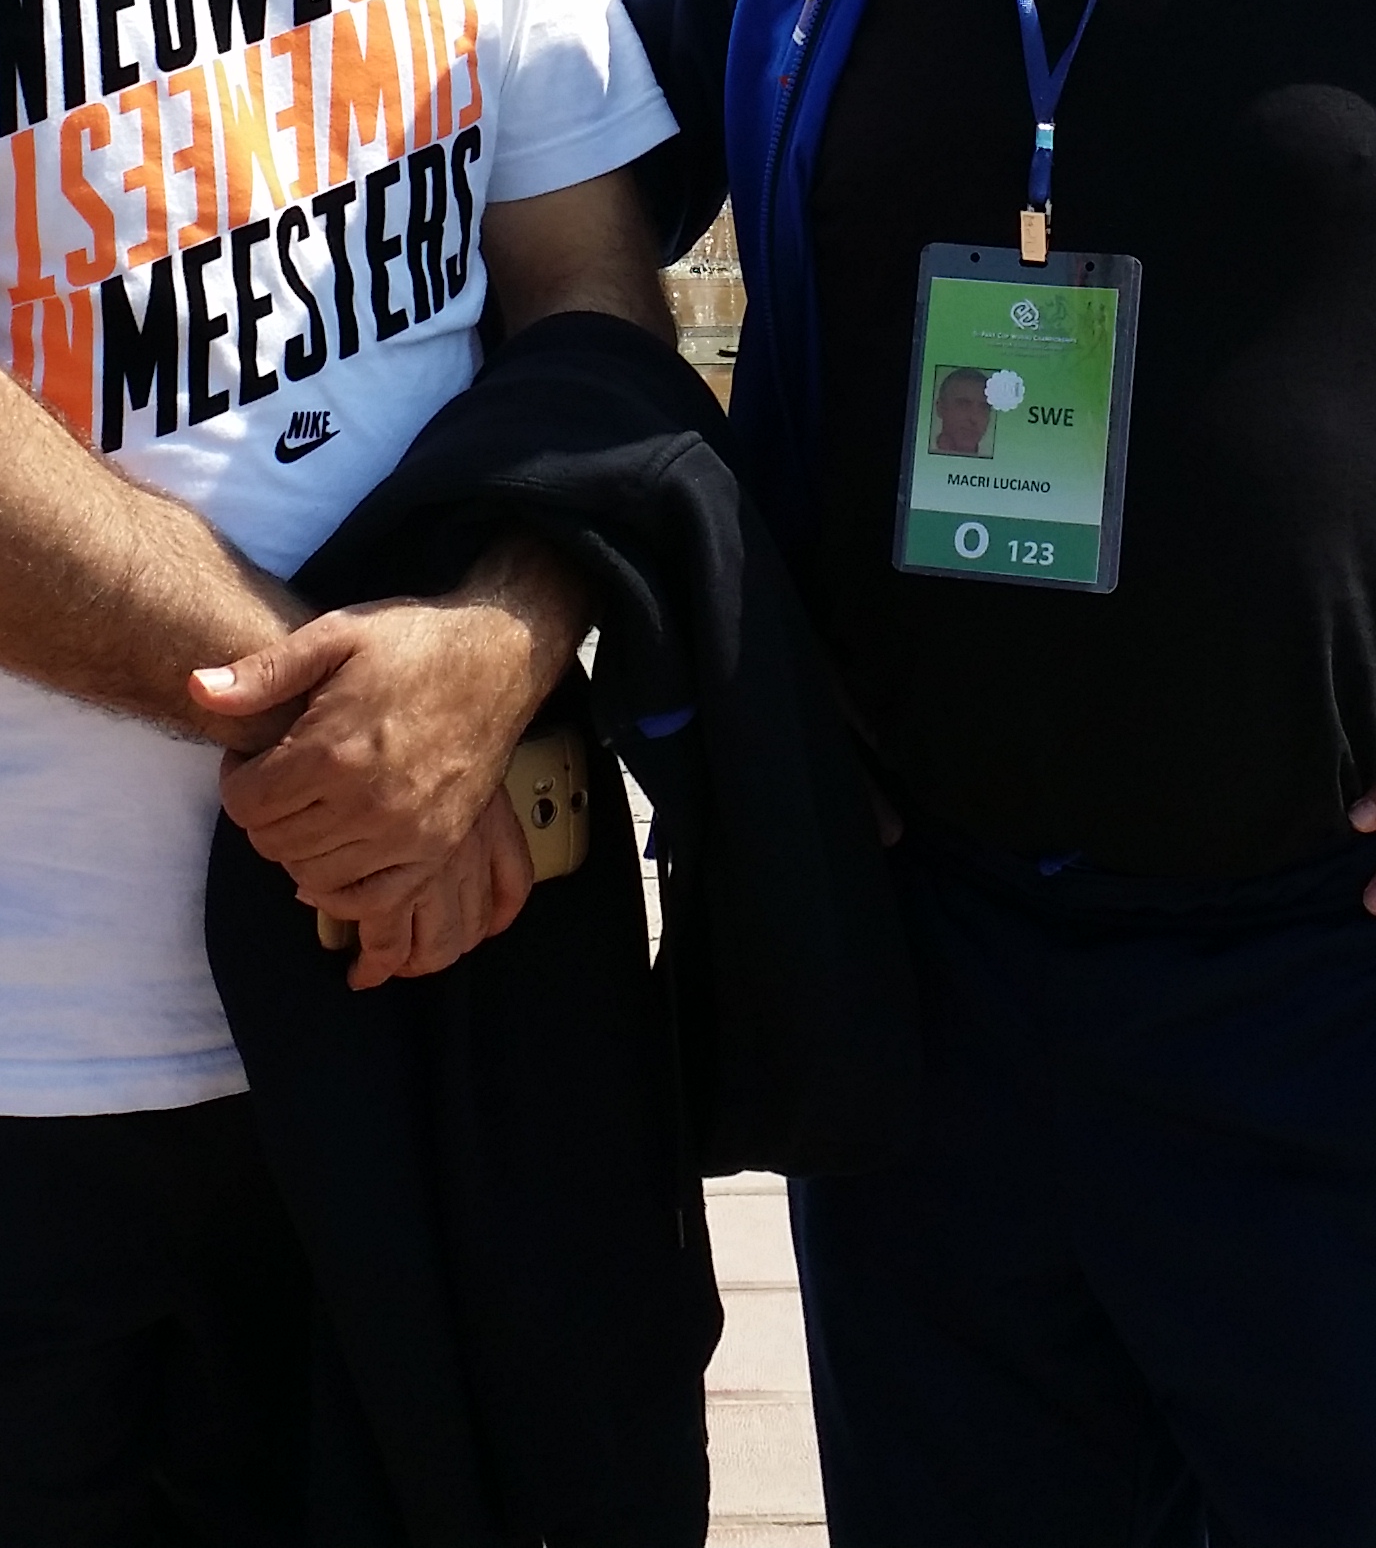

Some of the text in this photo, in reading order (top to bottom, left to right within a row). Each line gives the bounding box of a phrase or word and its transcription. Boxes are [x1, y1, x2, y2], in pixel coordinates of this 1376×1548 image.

[100, 125, 482, 453] MEESTERS
[286, 410, 331, 440] NIKE
[1028, 405, 1075, 427] SWE
[947, 473, 1051, 494] MACRI LUCIANO
[1008, 540, 1055, 566] 123
